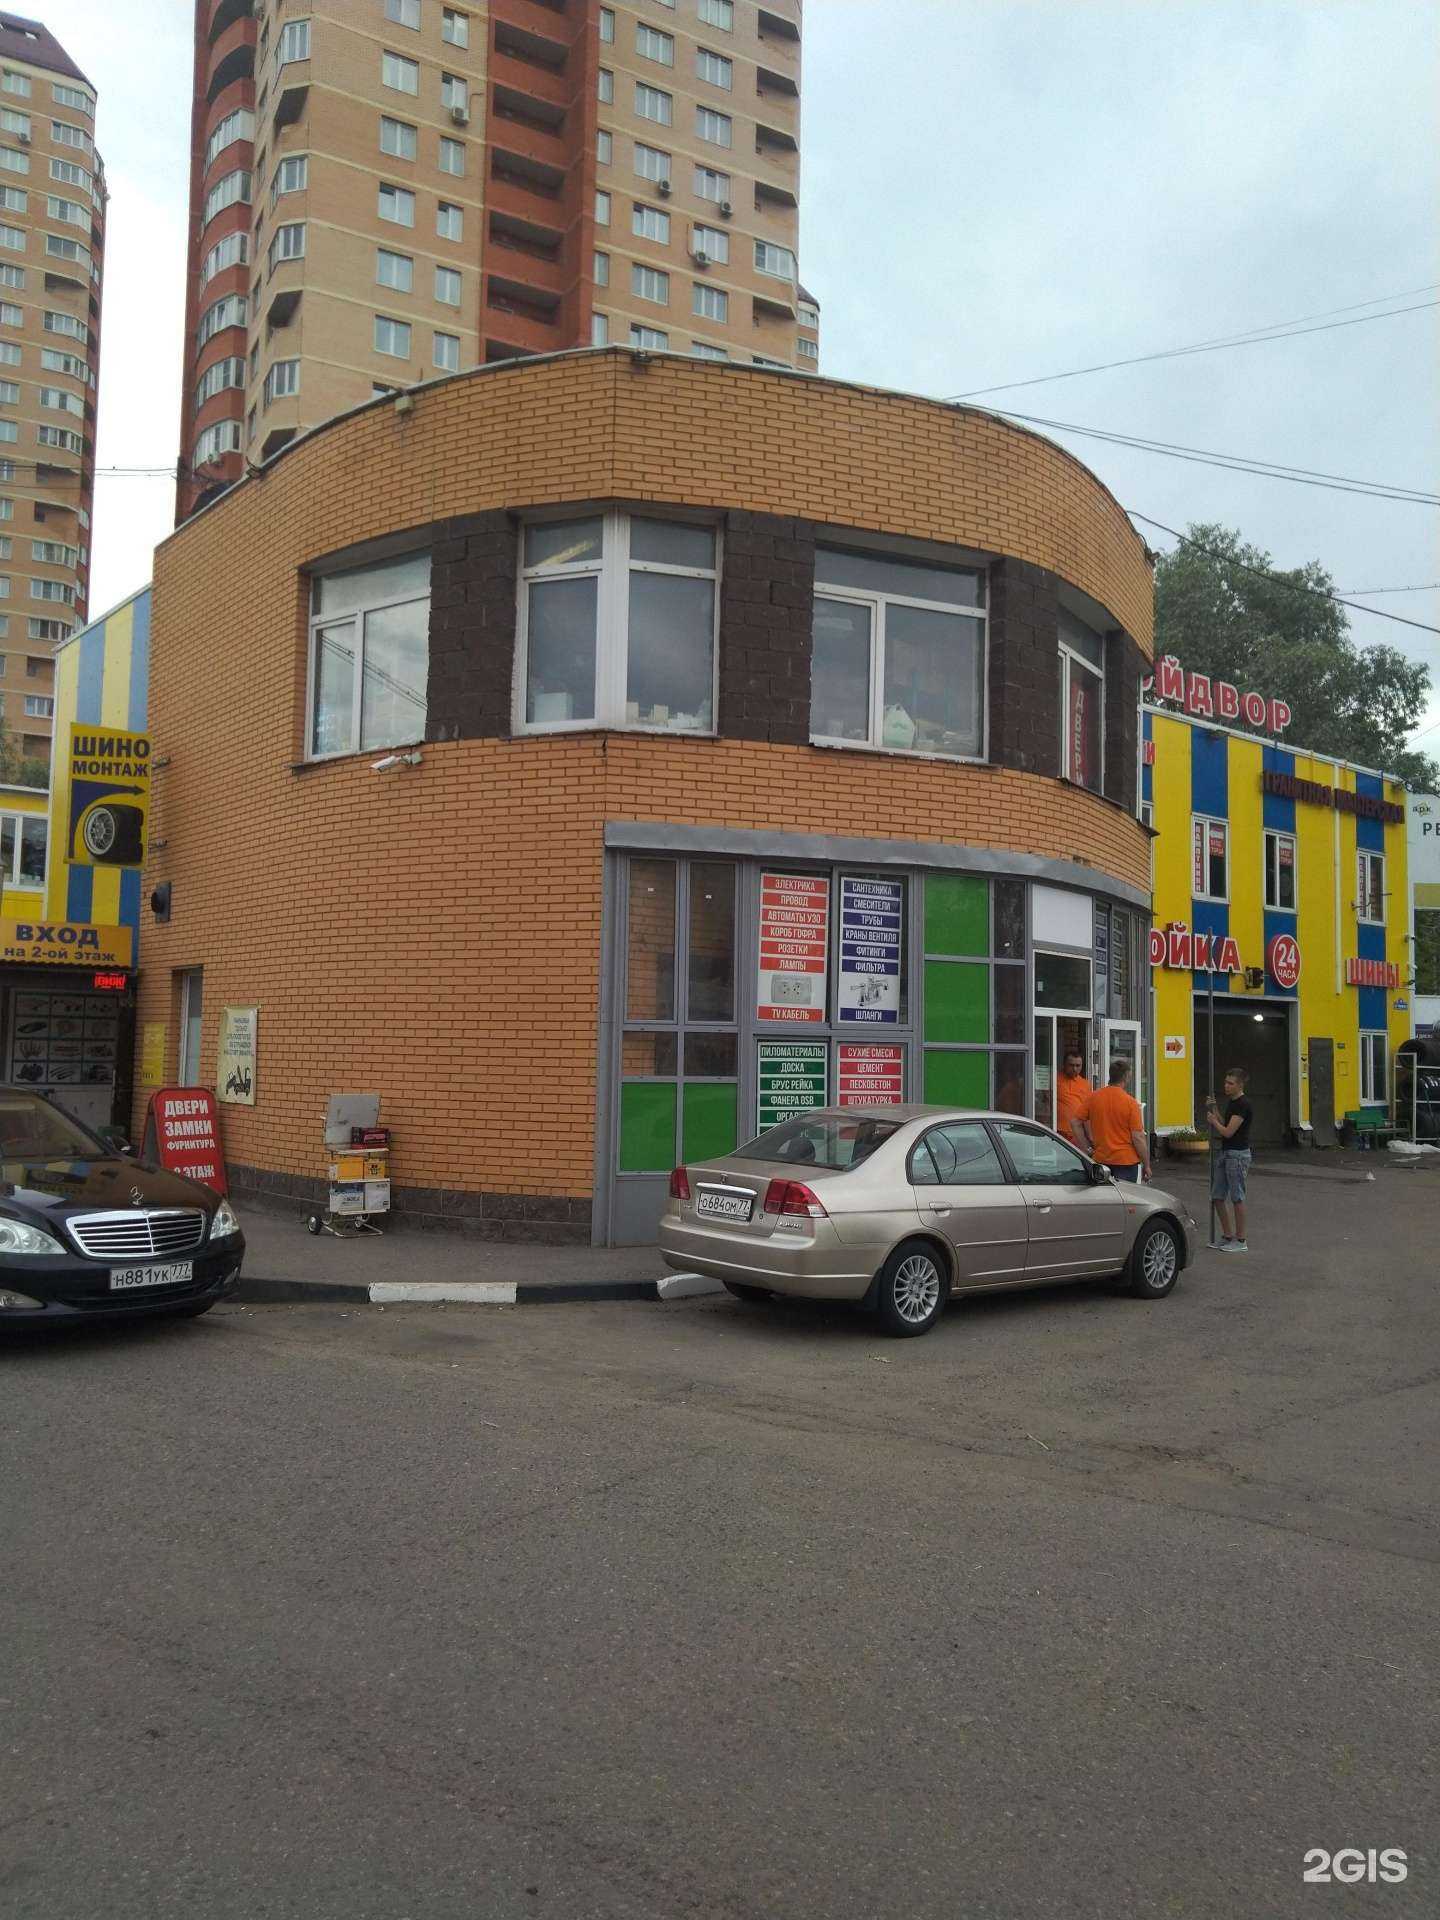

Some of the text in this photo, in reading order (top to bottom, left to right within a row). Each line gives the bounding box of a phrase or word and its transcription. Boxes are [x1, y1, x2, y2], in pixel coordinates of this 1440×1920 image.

[73, 735, 150, 759] ШИНО
[72, 760, 148, 777] МОНТАЖ
[775, 879, 815, 892] ЭЛЕКТРИКА
[852, 883, 892, 896] САНТЕХНИКА
[780, 894, 809, 907] ПРОВОД
[853, 899, 891, 911] СМЕСИТЕЛИ
[767, 910, 821, 923] АВТОМАТЫ УЗО
[861, 915, 883, 926] ТРУБЫ
[16, 924, 99, 949] ВХОД
[770, 926, 817, 939] КОРОБ ГОФРА
[845, 929, 867, 940] КРАНЫ
[4, 946, 116, 961] на 2-ой этаж
[777, 943, 808, 955] РОЗЕТКИ
[856, 946, 886, 957] ФИТИНГИ
[1278, 943, 1297, 968] 24
[778, 959, 806, 971] ЛАМПЫ
[855, 961, 885, 973] ФИЛЬТРА
[1278, 969, 1297, 979] ЧАСА
[772, 1008, 810, 1020] TV КАБЕЛЬ
[855, 1009, 882, 1021] ШЛАНГИ
[761, 1046, 825, 1058] ПИЛОМАТЕРИАЛЫ
[847, 1047, 894, 1058] СУХИЕ СМЕСИ
[780, 1062, 805, 1074] ДОСКА
[857, 1063, 884, 1074] ЦЕМЕНТ
[771, 1077, 813, 1090] БРУС РЕЙКА
[849, 1079, 892, 1090] ПЕСКОБЕТОН
[770, 1095, 800, 1106] ФАНЕРА
[847, 1096, 893, 1105] ШТУКАТУРКА
[165, 1100, 208, 1118] ДВЕРИ
[164, 1120, 212, 1137] ЗАМКИ
[167, 1139, 216, 1151] ФУРНИТУРА
[182, 1164, 216, 1179] ЭТАЖ
